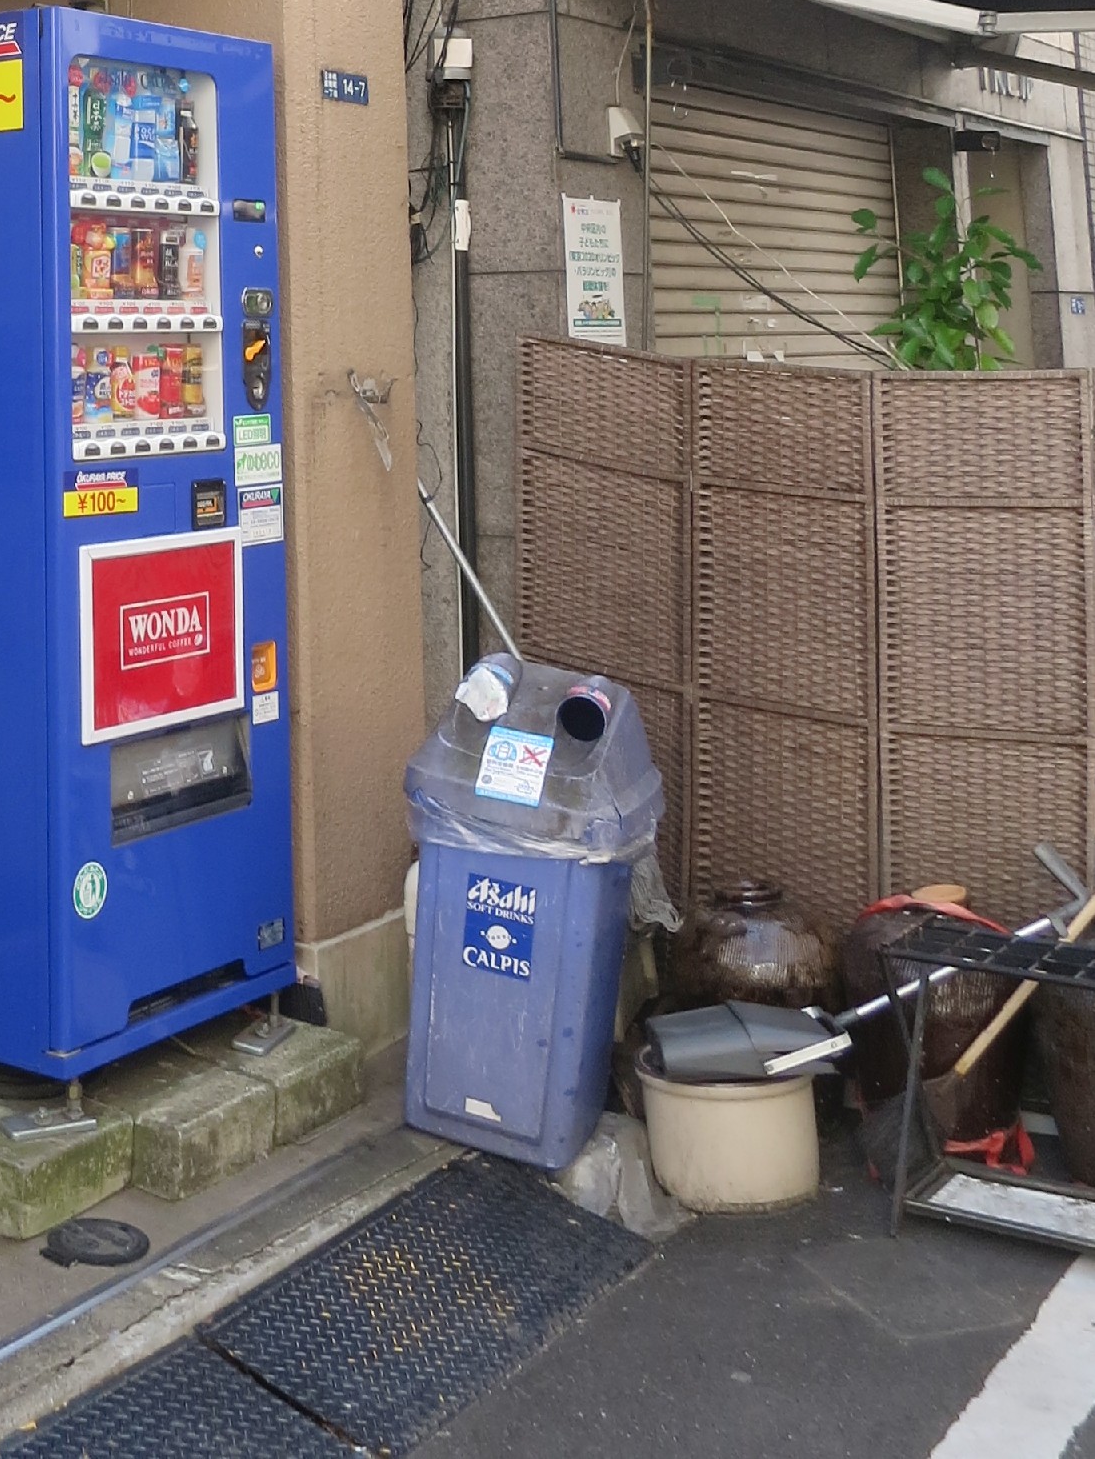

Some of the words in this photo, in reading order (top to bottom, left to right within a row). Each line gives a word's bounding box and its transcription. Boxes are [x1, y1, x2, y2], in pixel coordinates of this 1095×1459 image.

[343, 79, 365, 97] 14-7
[128, 605, 202, 643] WONDA
[128, 641, 166, 657] WONDERFUL
[168, 637, 192, 650] COFFEE
[467, 878, 536, 916] Asahi
[466, 901, 493, 915] SOFT
[495, 907, 535, 926] DRINKS
[462, 945, 530, 977] CALPIS
